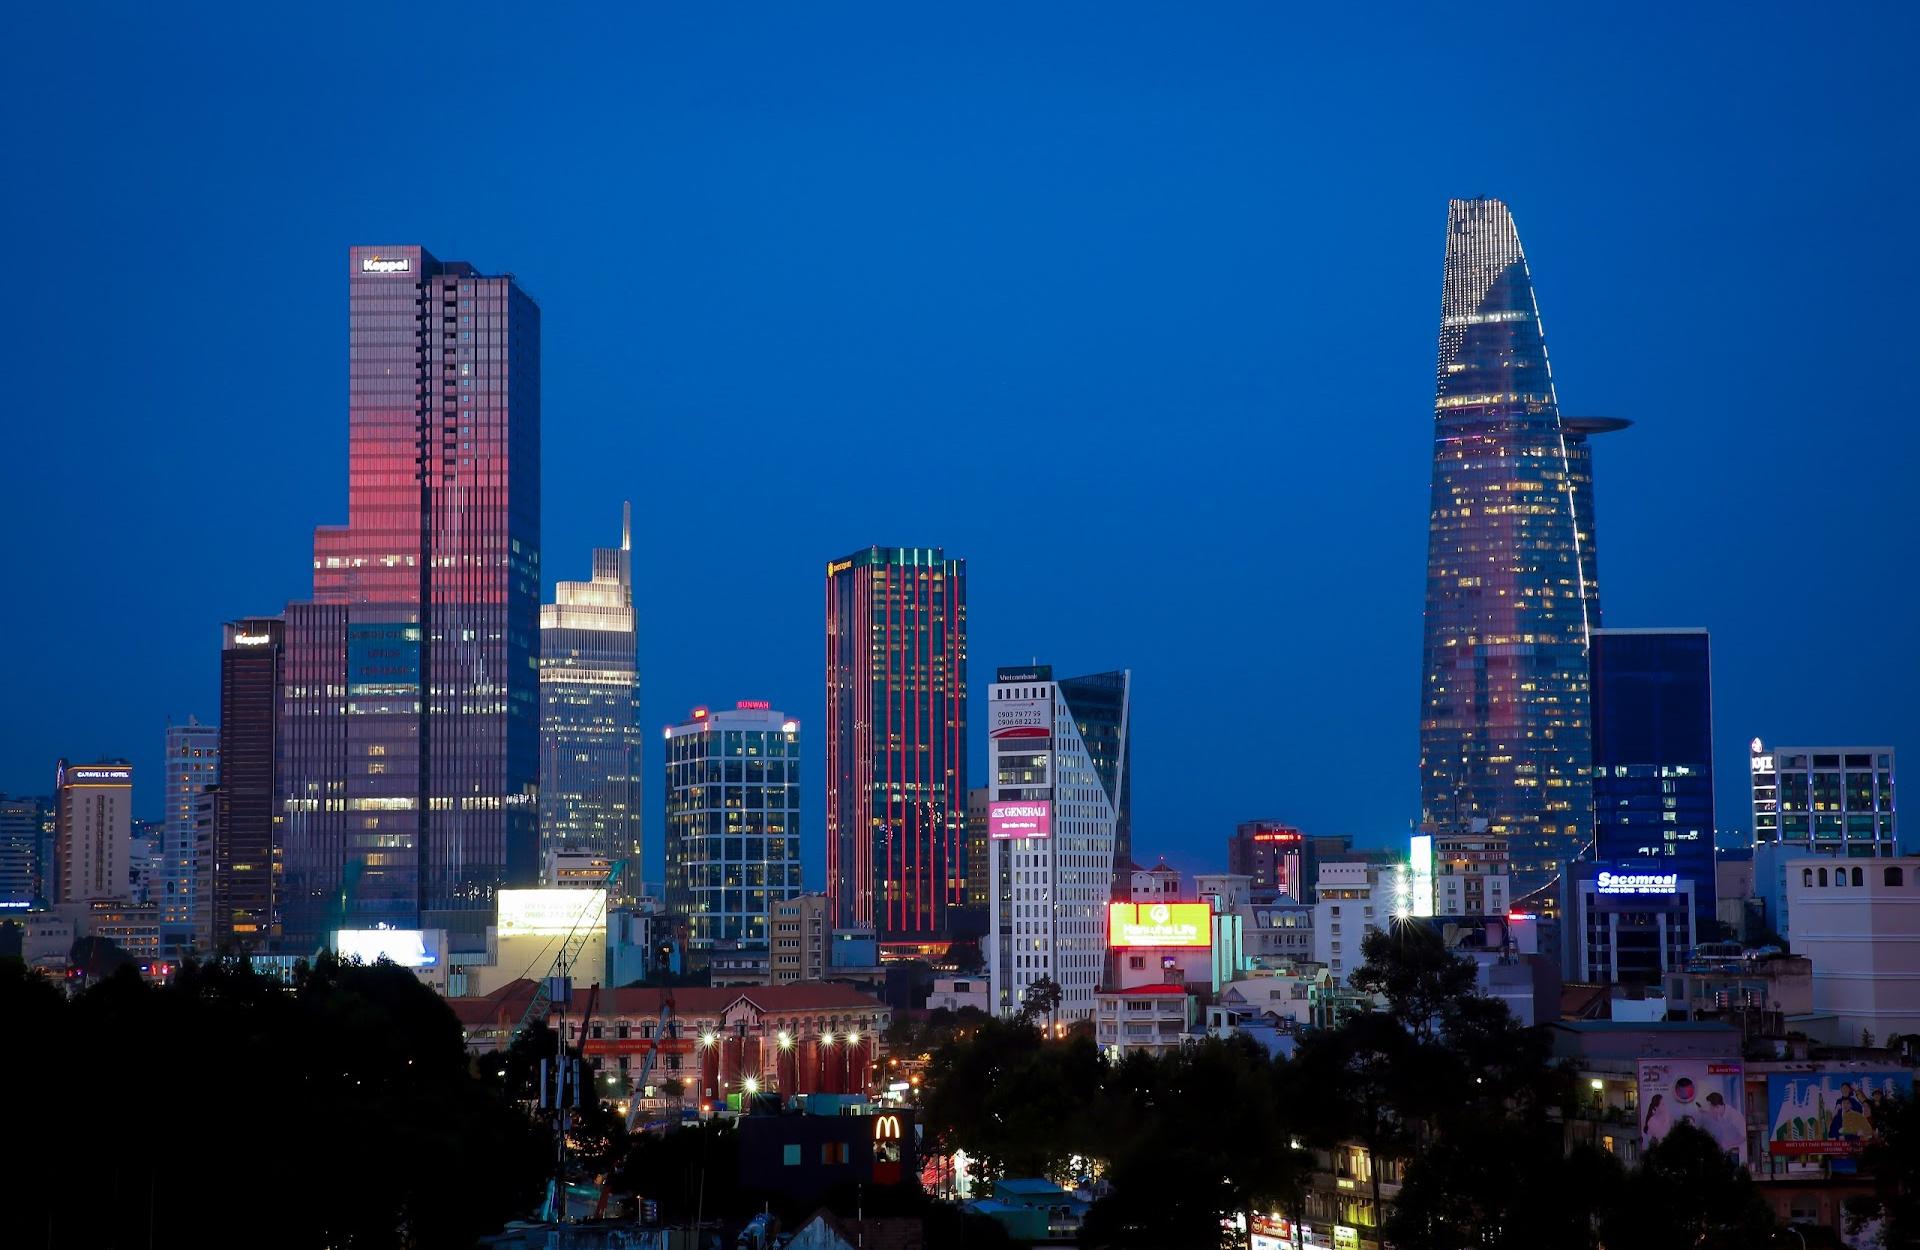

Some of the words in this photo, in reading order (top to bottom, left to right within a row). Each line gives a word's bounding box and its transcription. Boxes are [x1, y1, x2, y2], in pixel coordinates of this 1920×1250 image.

[363, 260, 408, 272] Keppel
[737, 701, 769, 709] SUNWAH
[1004, 807, 1046, 817] GENERALI
[1598, 872, 1677, 887] Sacomreal
